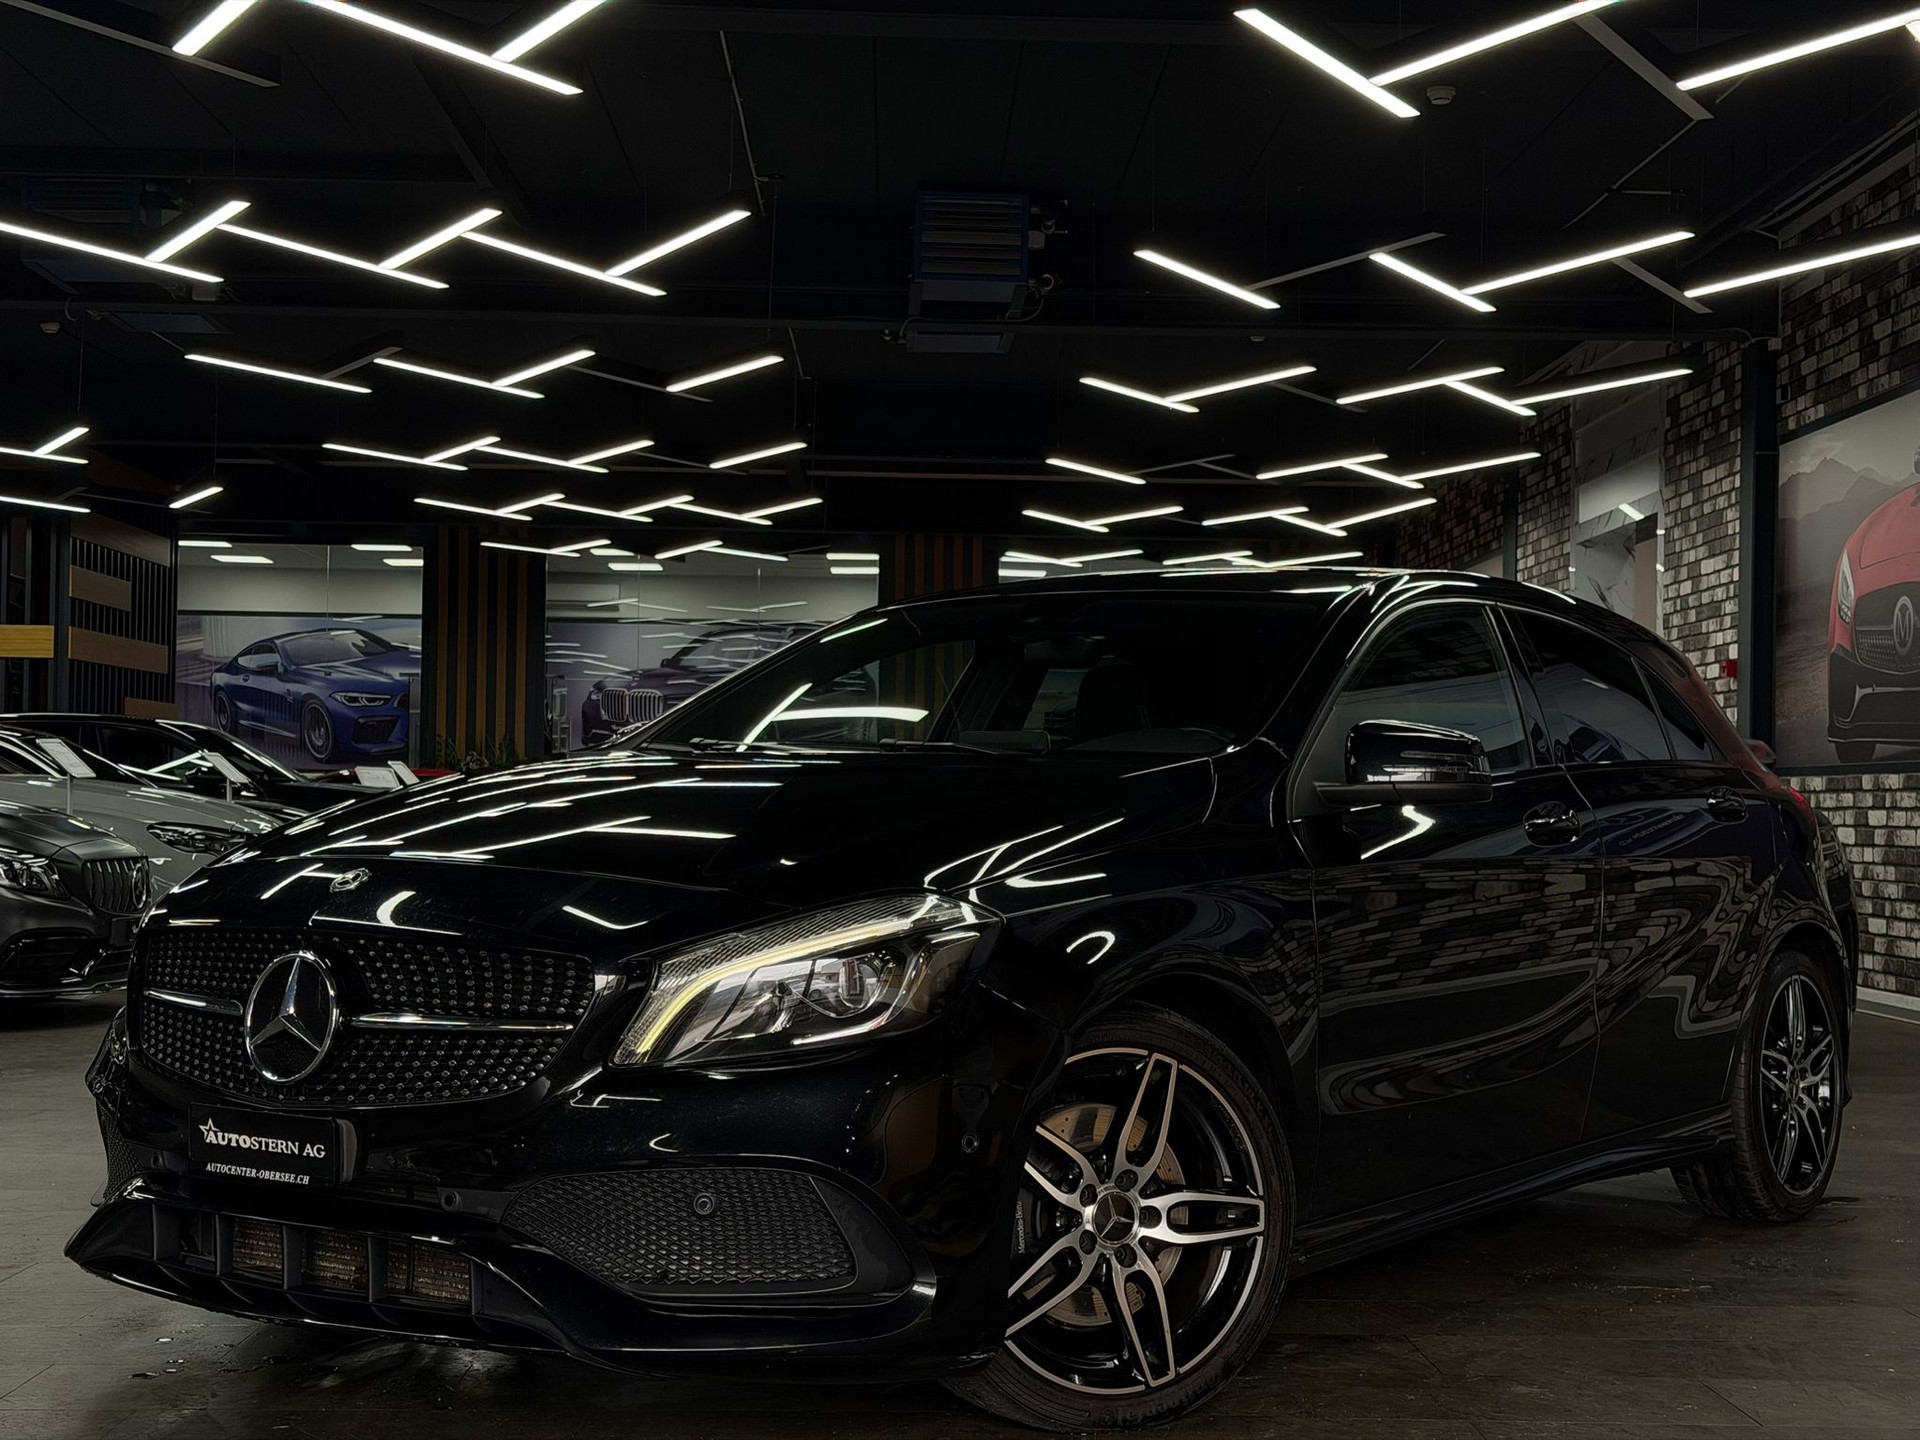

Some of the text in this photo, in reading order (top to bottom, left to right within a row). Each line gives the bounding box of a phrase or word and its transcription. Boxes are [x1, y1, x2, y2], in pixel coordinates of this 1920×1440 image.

[205, 1131, 326, 1158] AUTOSTERN AG
[205, 1162, 310, 1185] AUTOCENTER-OBERSEE.CH
